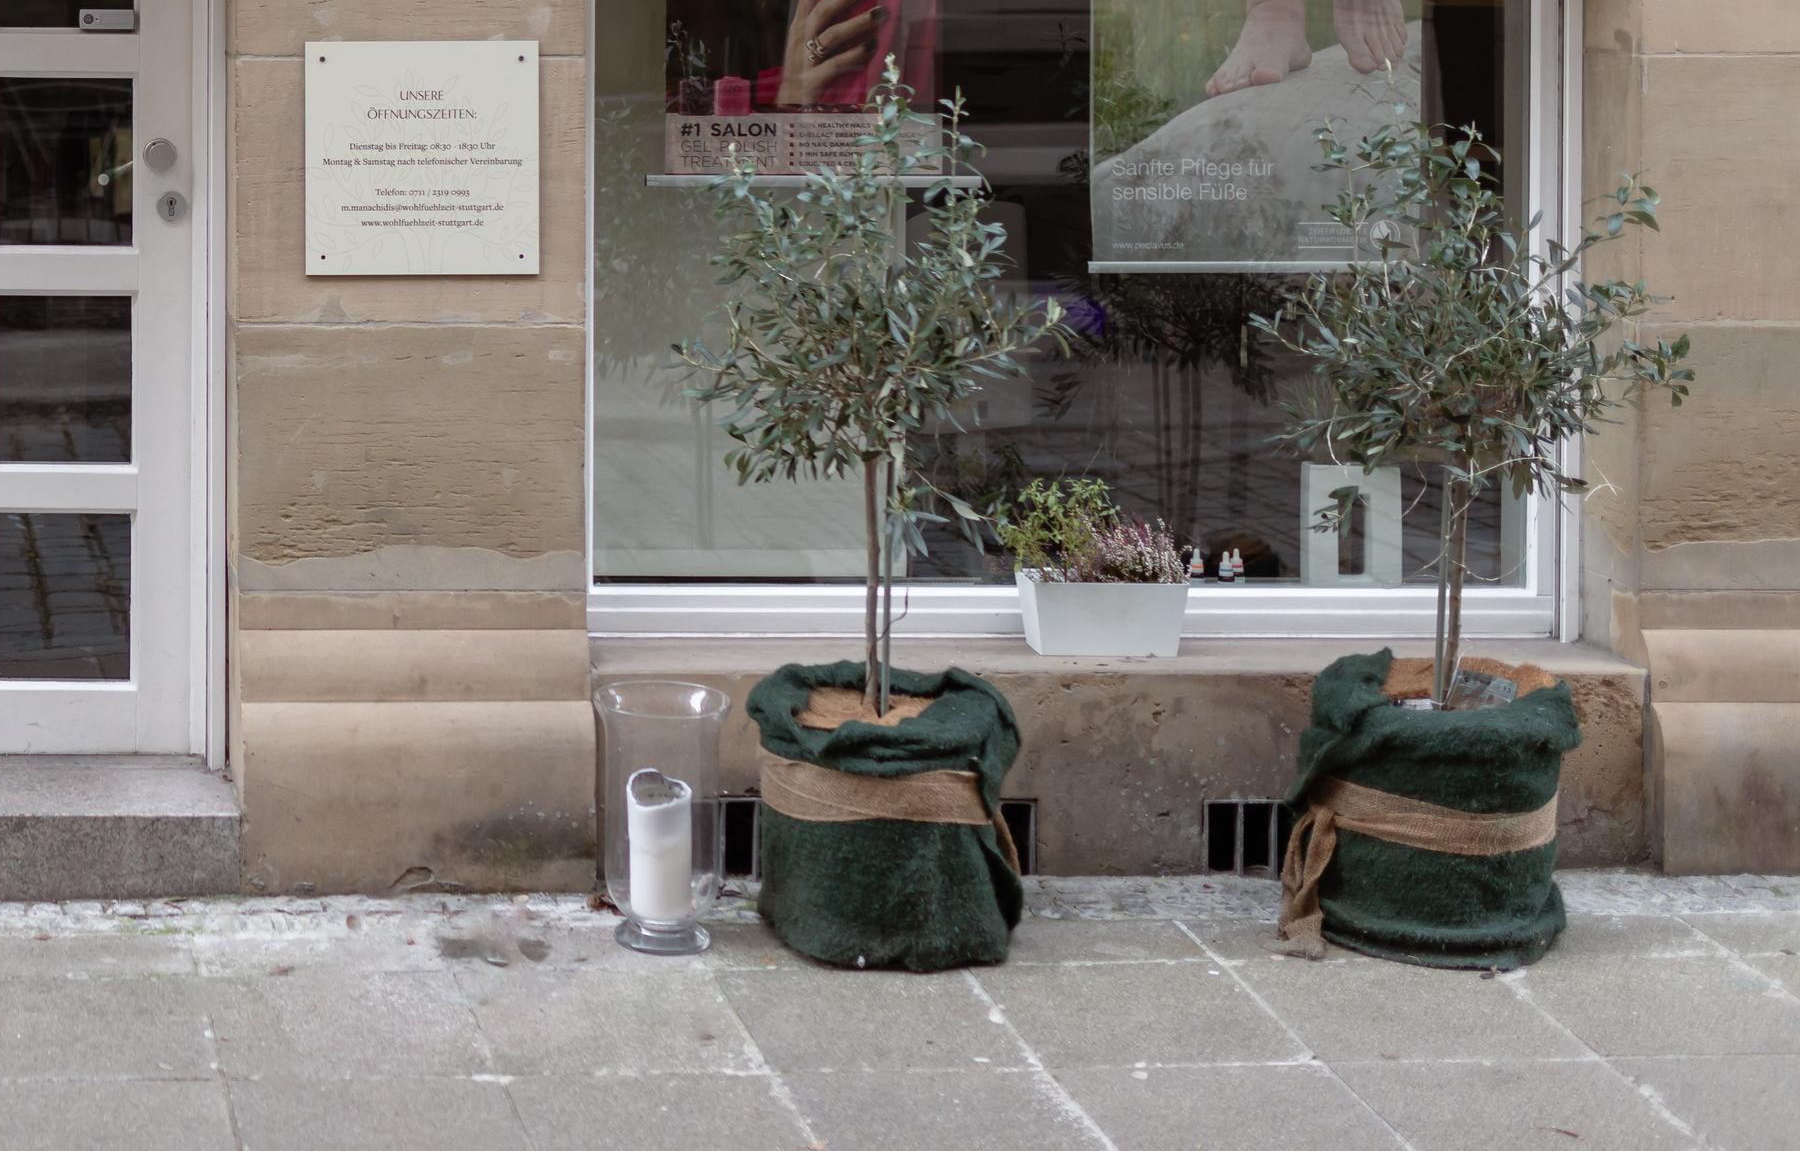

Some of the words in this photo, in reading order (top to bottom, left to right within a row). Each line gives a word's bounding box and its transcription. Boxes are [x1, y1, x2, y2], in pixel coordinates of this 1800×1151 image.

[399, 90, 444, 101] UNSERE
[367, 106, 478, 120] ÖFFNUNGSZEITEN:
[680, 123, 701, 138] #1
[710, 123, 777, 138] SALON
[349, 142, 384, 151] Dienstag
[385, 142, 397, 150] bis
[398, 142, 428, 151] Freitag:
[430, 143, 451, 151] 08:30
[458, 143, 478, 151] 18:30
[480, 142, 496, 150] Uhr
[680, 140, 712, 153] GEL
[719, 140, 777, 153] POLISH
[322, 158, 352, 167] Montag
[362, 158, 395, 167] Samstag
[470, 157, 523, 167] Vereinbarung
[1112, 159, 1174, 176] Sanfte
[1181, 158, 1242, 180] Pflege
[1248, 159, 1274, 176] für
[375, 188, 407, 196] Telefon:
[409, 189, 425, 197] 0711
[432, 189, 449, 197] 2319
[451, 189, 470, 197] 0993
[1112, 183, 1192, 201] sensible
[1200, 183, 1248, 201] Füße
[341, 203, 504, 212] m.manachidis@wohlfuehlzeit-stuttgart.de
[361, 219, 484, 228] www.wohlfuehlzeit-stuttgart.de
[1308, 227, 1368, 235] ZERTIFIZIETE
[1298, 236, 1368, 244] NATURKOSMIK
[1112, 242, 1184, 251] www.peclavus.de
